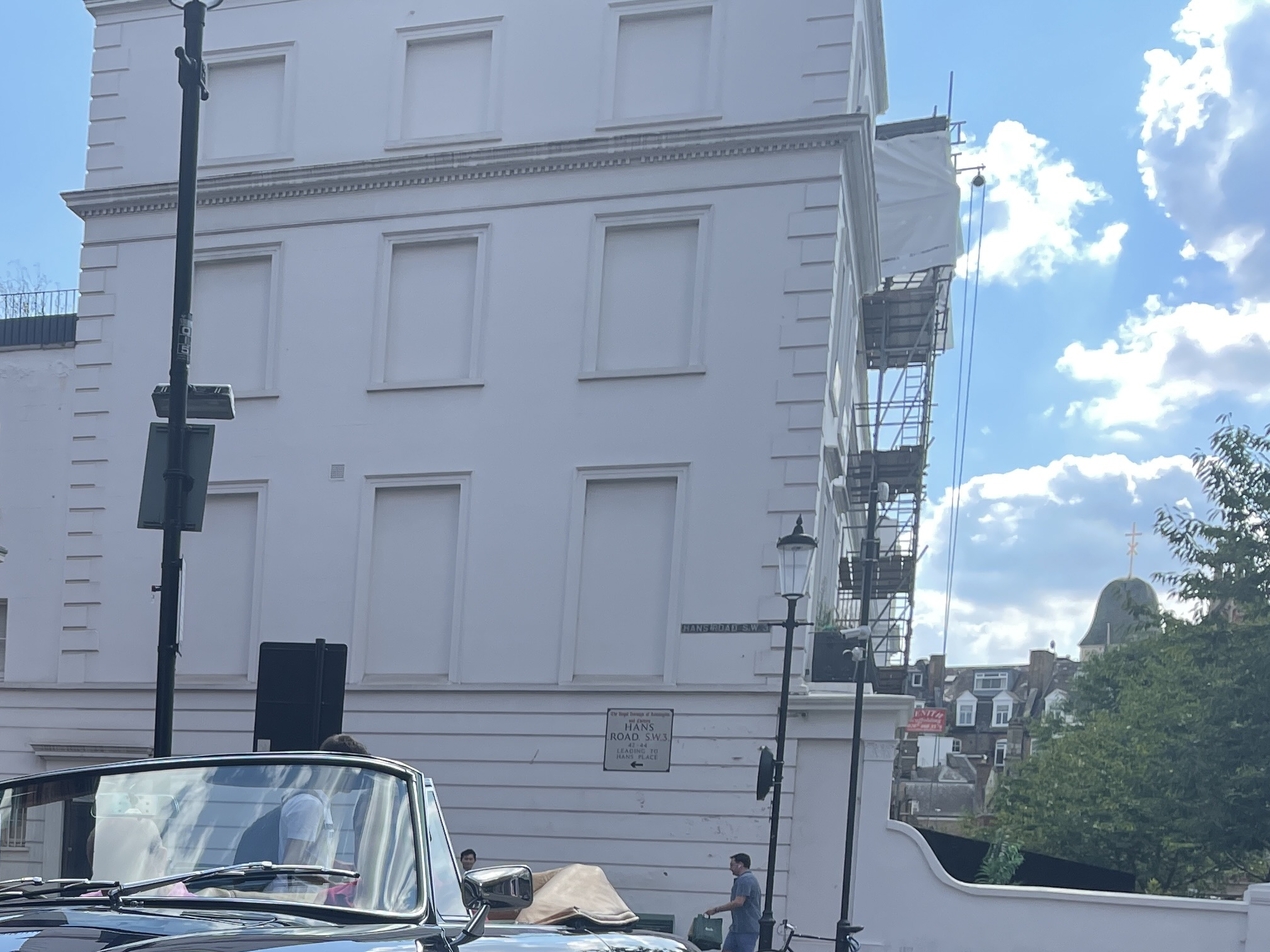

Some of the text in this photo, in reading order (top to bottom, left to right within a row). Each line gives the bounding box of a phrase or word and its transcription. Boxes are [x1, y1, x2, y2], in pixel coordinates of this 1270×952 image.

[683, 624, 709, 632] HANS
[710, 624, 738, 632] ROAD
[625, 723, 654, 731] HANS
